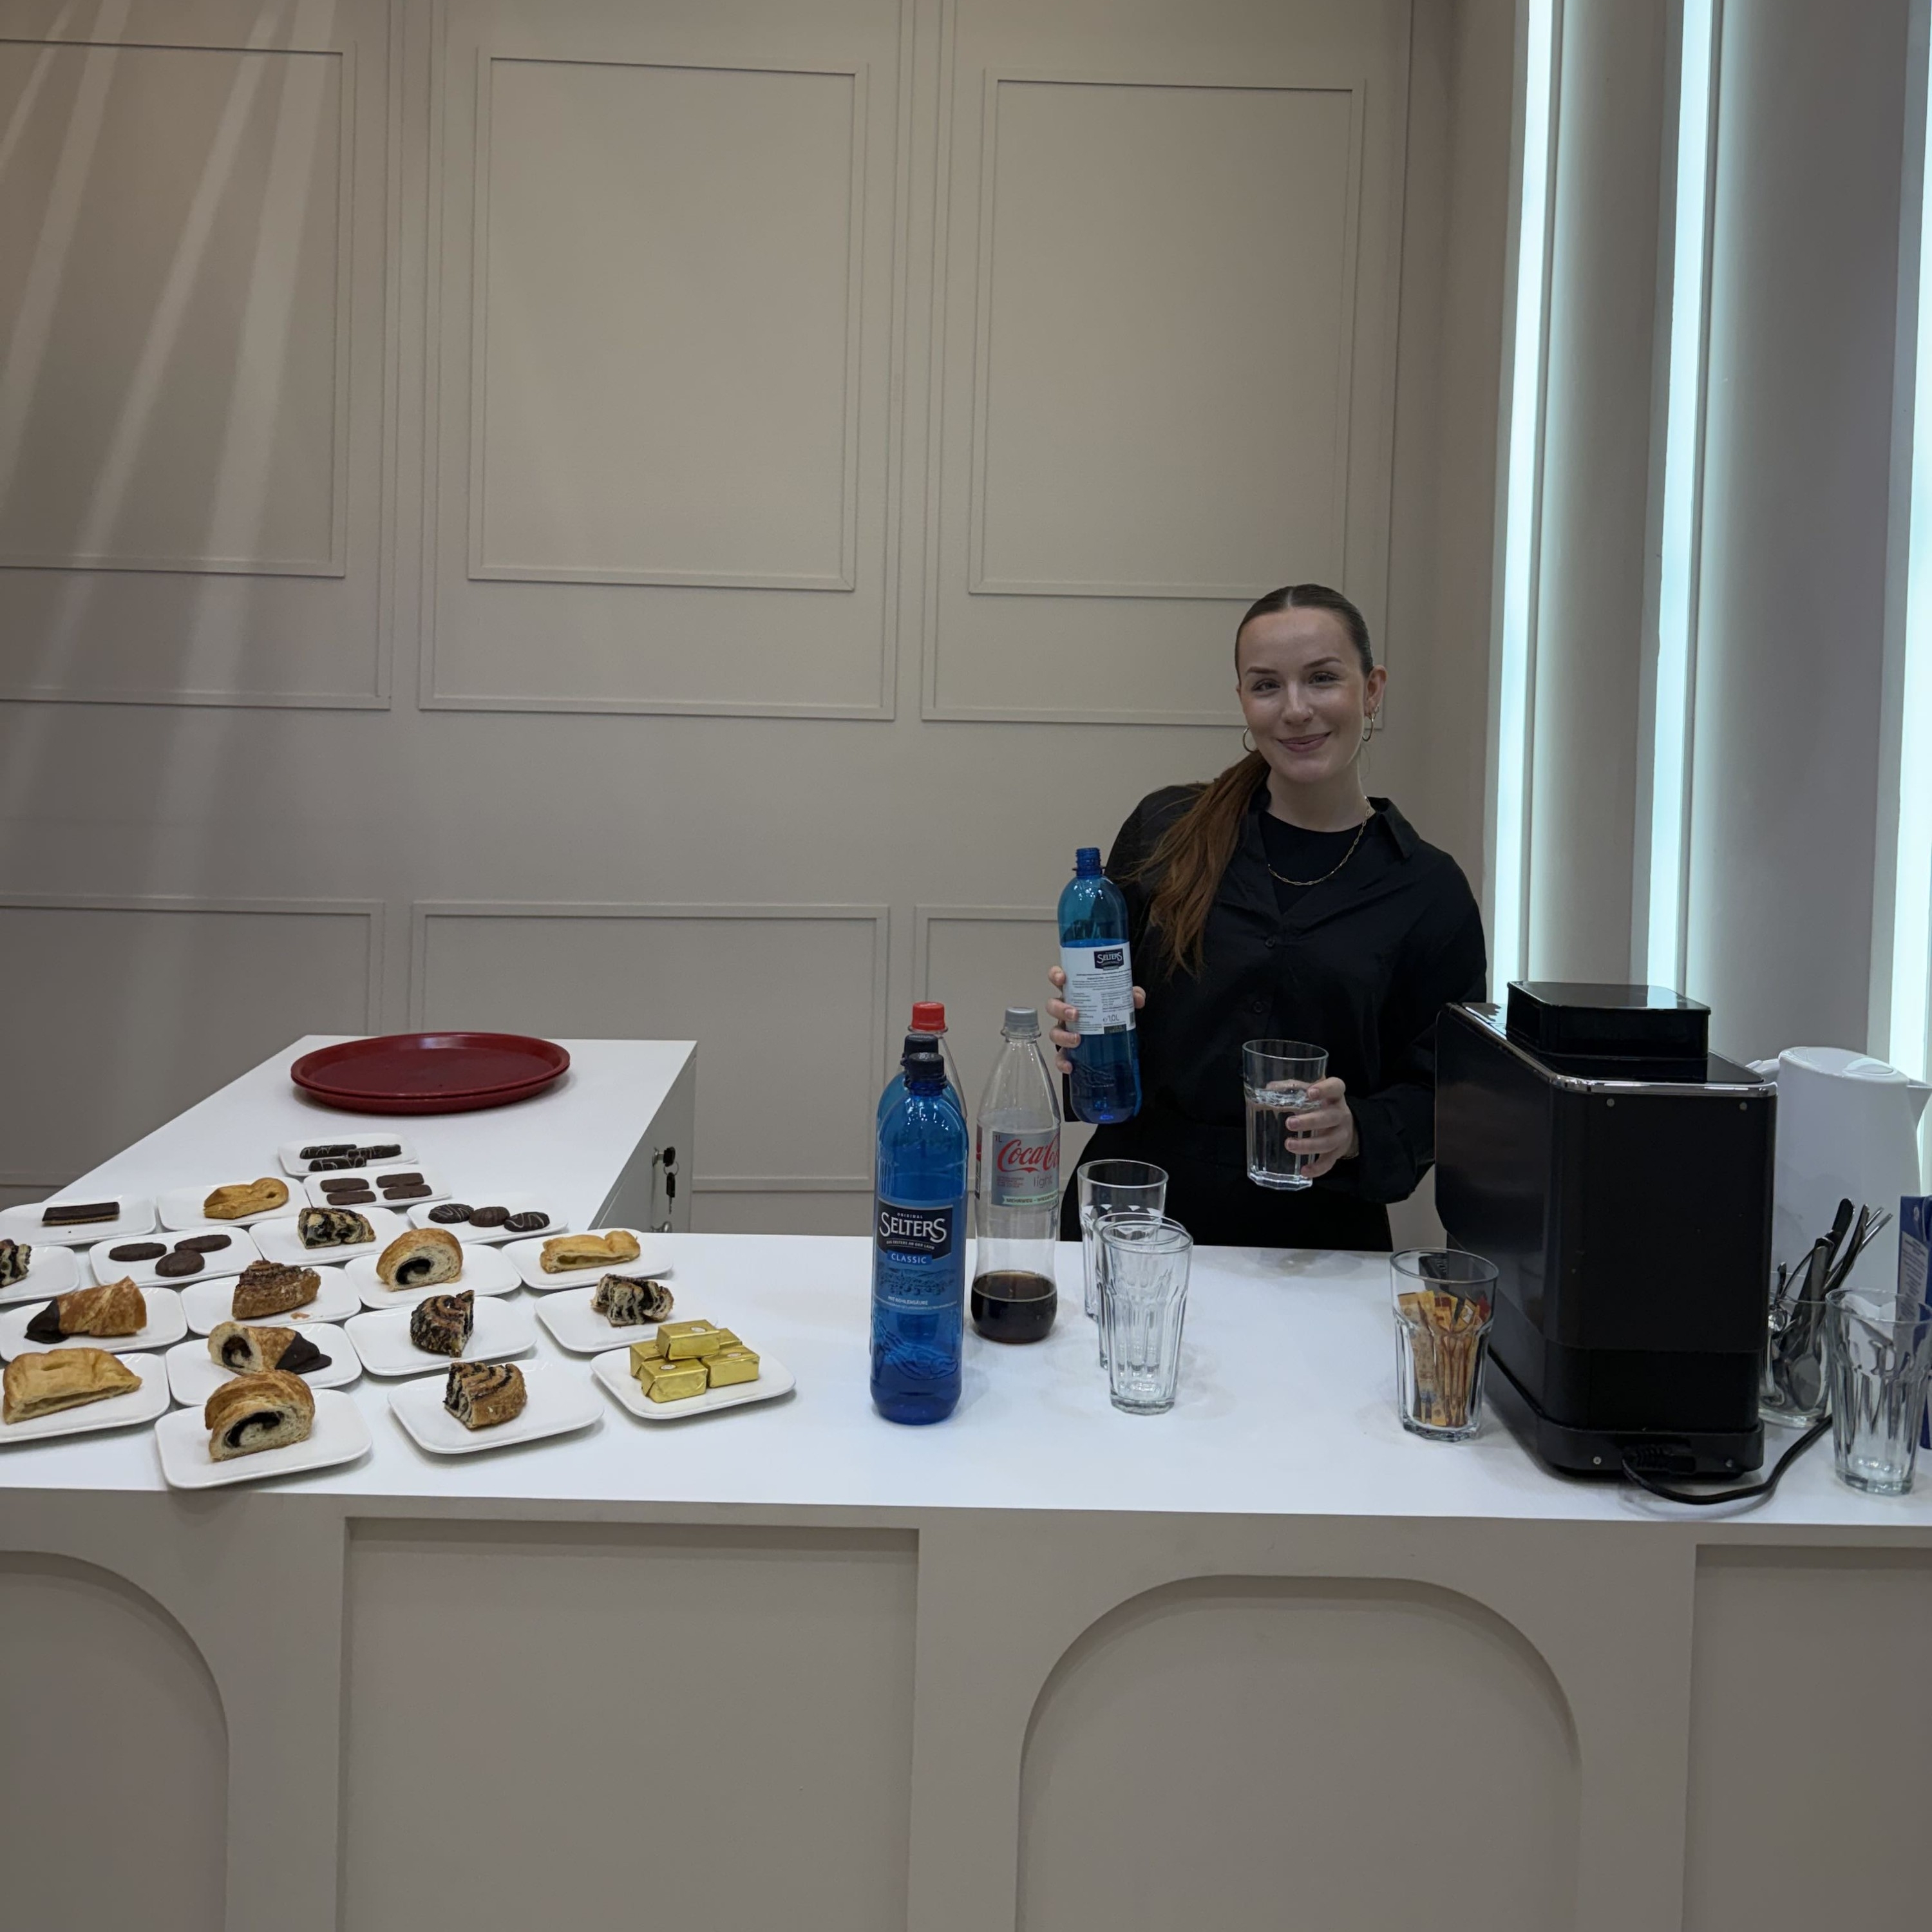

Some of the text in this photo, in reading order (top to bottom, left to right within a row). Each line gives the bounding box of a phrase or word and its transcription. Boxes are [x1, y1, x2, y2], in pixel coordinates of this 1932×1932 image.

[1096, 952, 1122, 963] SELTERS
[1034, 1175, 1052, 1189] light
[879, 1212, 947, 1243] SELTERS
[891, 1253, 927, 1264] CLASSIC
